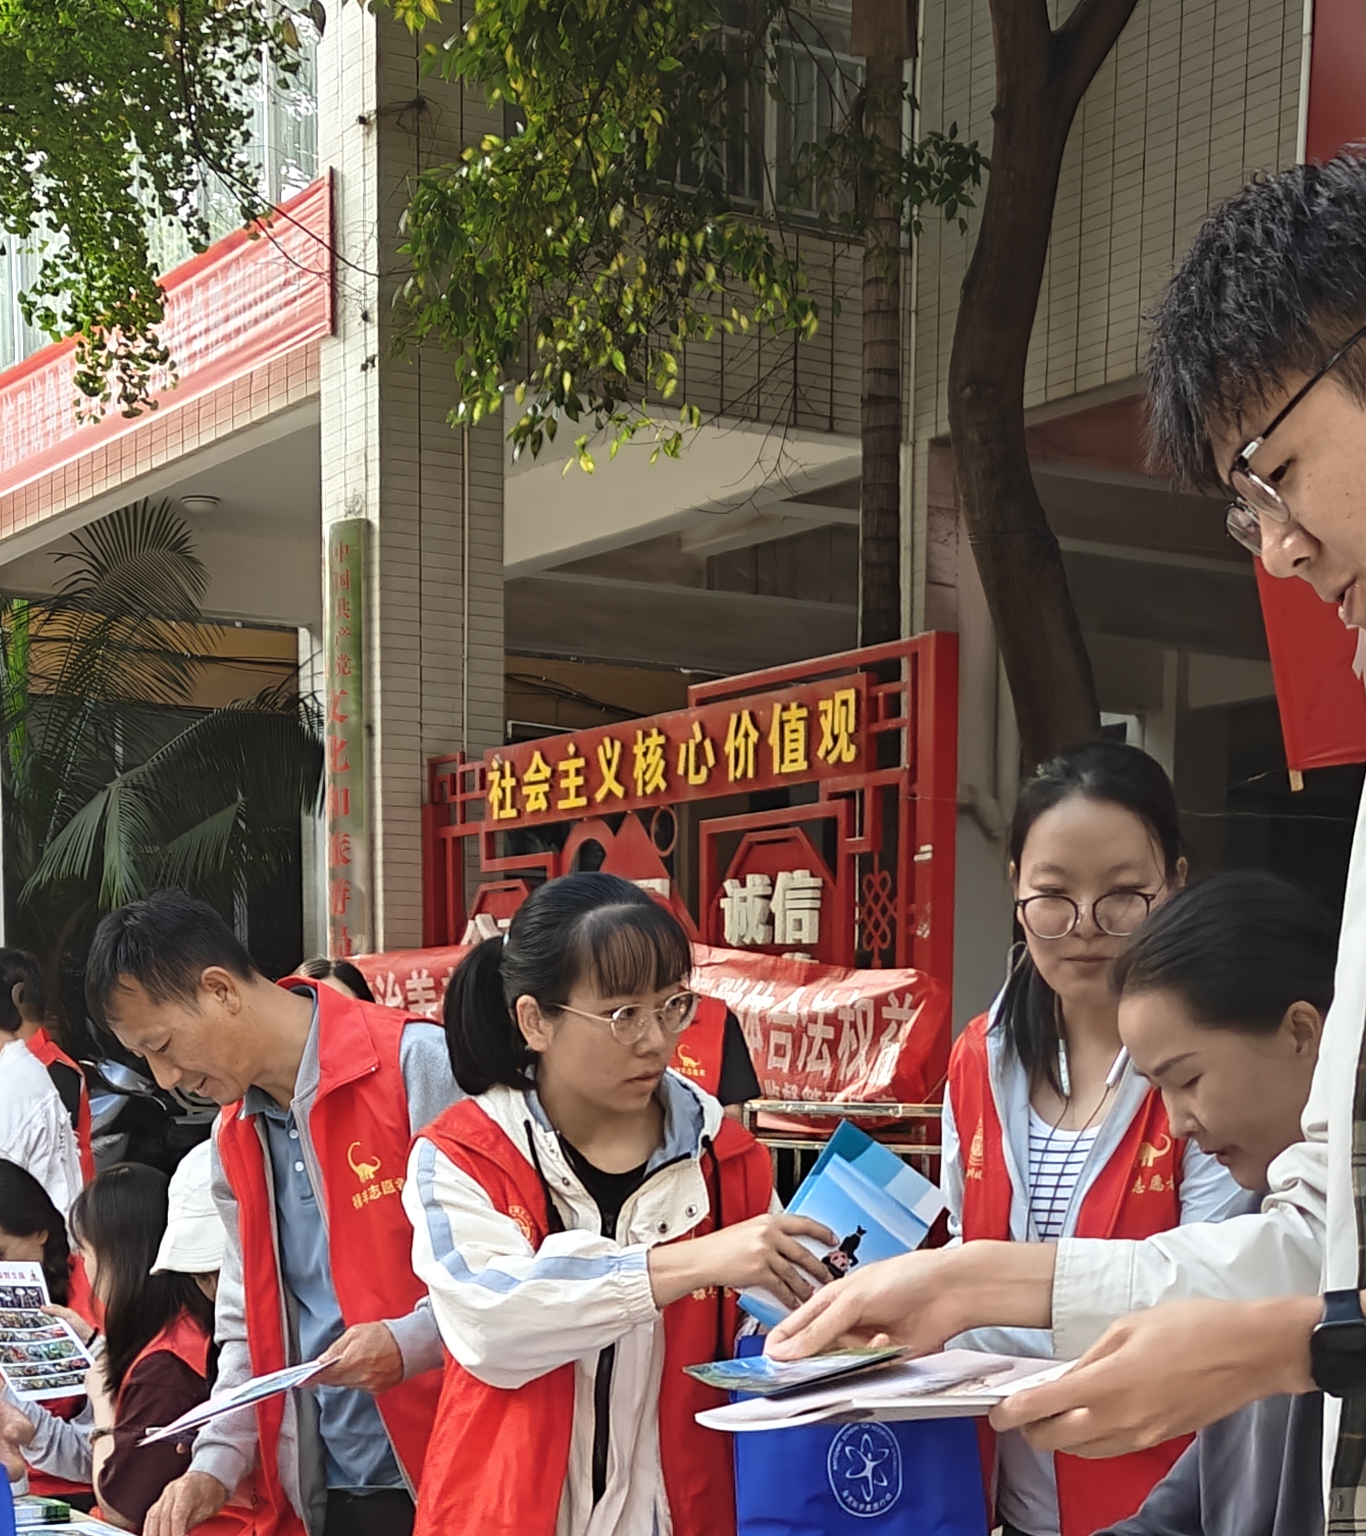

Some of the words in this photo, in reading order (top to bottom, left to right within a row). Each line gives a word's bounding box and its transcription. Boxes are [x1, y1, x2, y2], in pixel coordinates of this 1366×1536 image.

[487, 686, 858, 821] 社会主义核心价值观
[720, 868, 824, 947] 诚信
